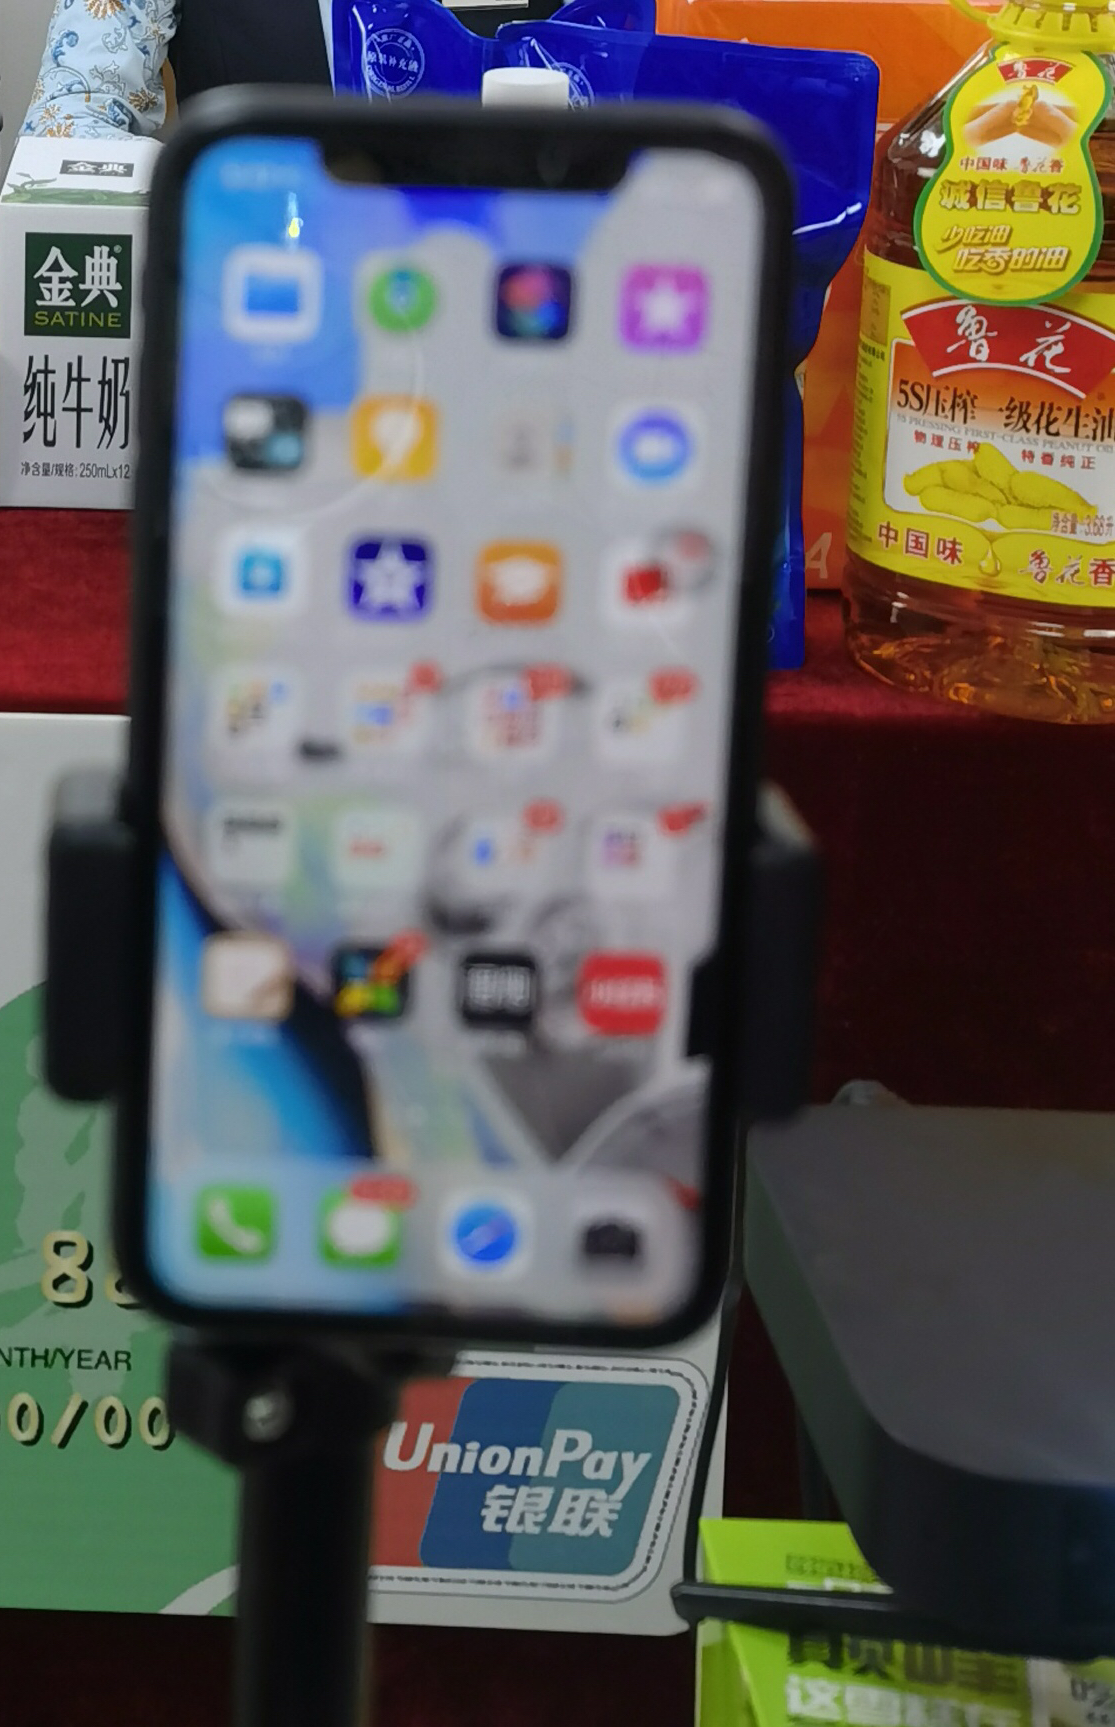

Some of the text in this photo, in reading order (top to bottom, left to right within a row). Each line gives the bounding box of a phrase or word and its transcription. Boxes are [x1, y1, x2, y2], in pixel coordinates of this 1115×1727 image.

[959, 155, 1008, 172] 中国味
[939, 179, 1082, 215] 诚信鲁花
[32, 244, 124, 308] 金典
[32, 310, 122, 328] SATINE
[946, 303, 1073, 374] 鲁花
[22, 354, 131, 450] 纯牛奶
[878, 520, 964, 565] 中国味
[383, 1421, 652, 1500] UnionPay
[481, 1483, 623, 1538] 银联
